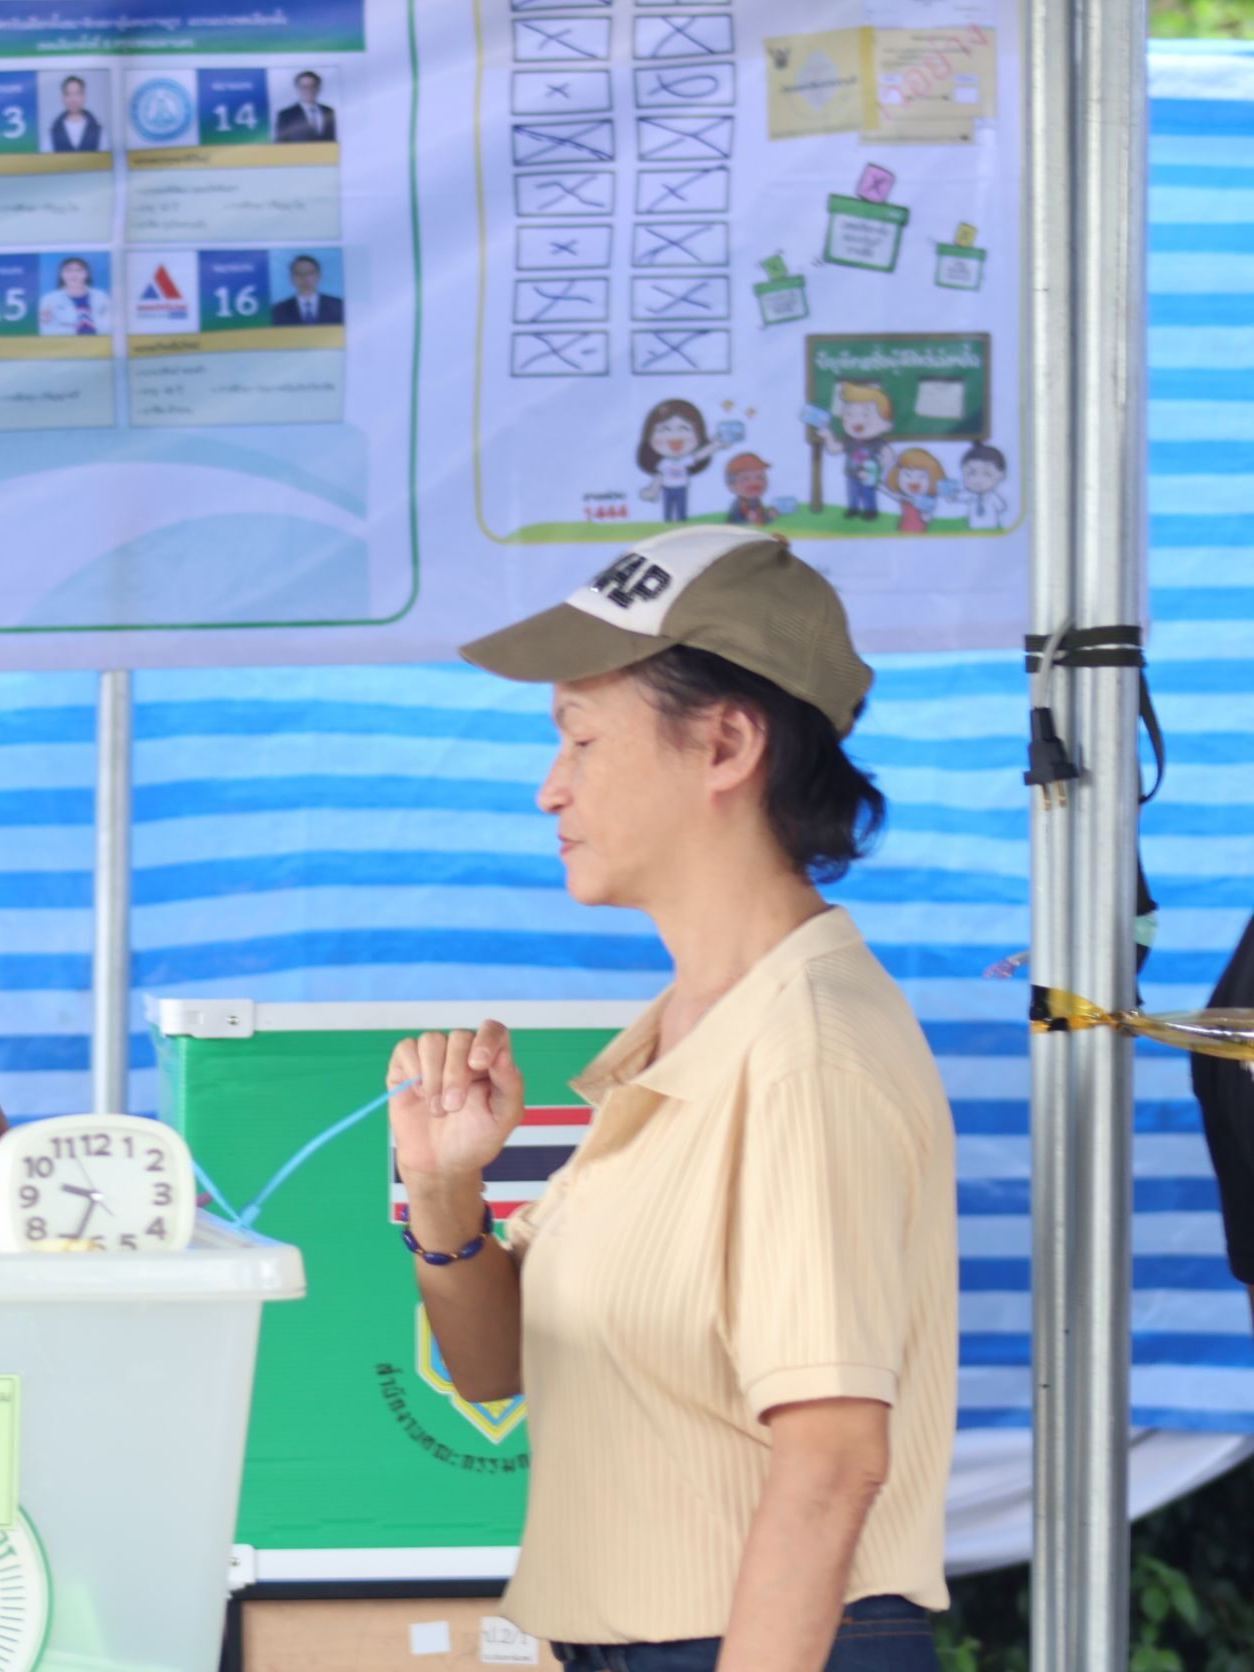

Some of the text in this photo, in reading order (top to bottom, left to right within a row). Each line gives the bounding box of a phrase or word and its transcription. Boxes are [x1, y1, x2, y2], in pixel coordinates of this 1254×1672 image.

[214, 103, 257, 132] 14
[214, 286, 259, 318] 16
[50, 1136, 77, 1159] 11
[80, 1133, 112, 1156] 12
[122, 1136, 134, 1159] 1
[22, 1156, 54, 1179] 10
[145, 1148, 164, 1171] 2
[19, 1185, 40, 1208] 9
[152, 1182, 172, 1206] 3
[25, 1216, 47, 1241] 8
[145, 1216, 167, 1239] 4
